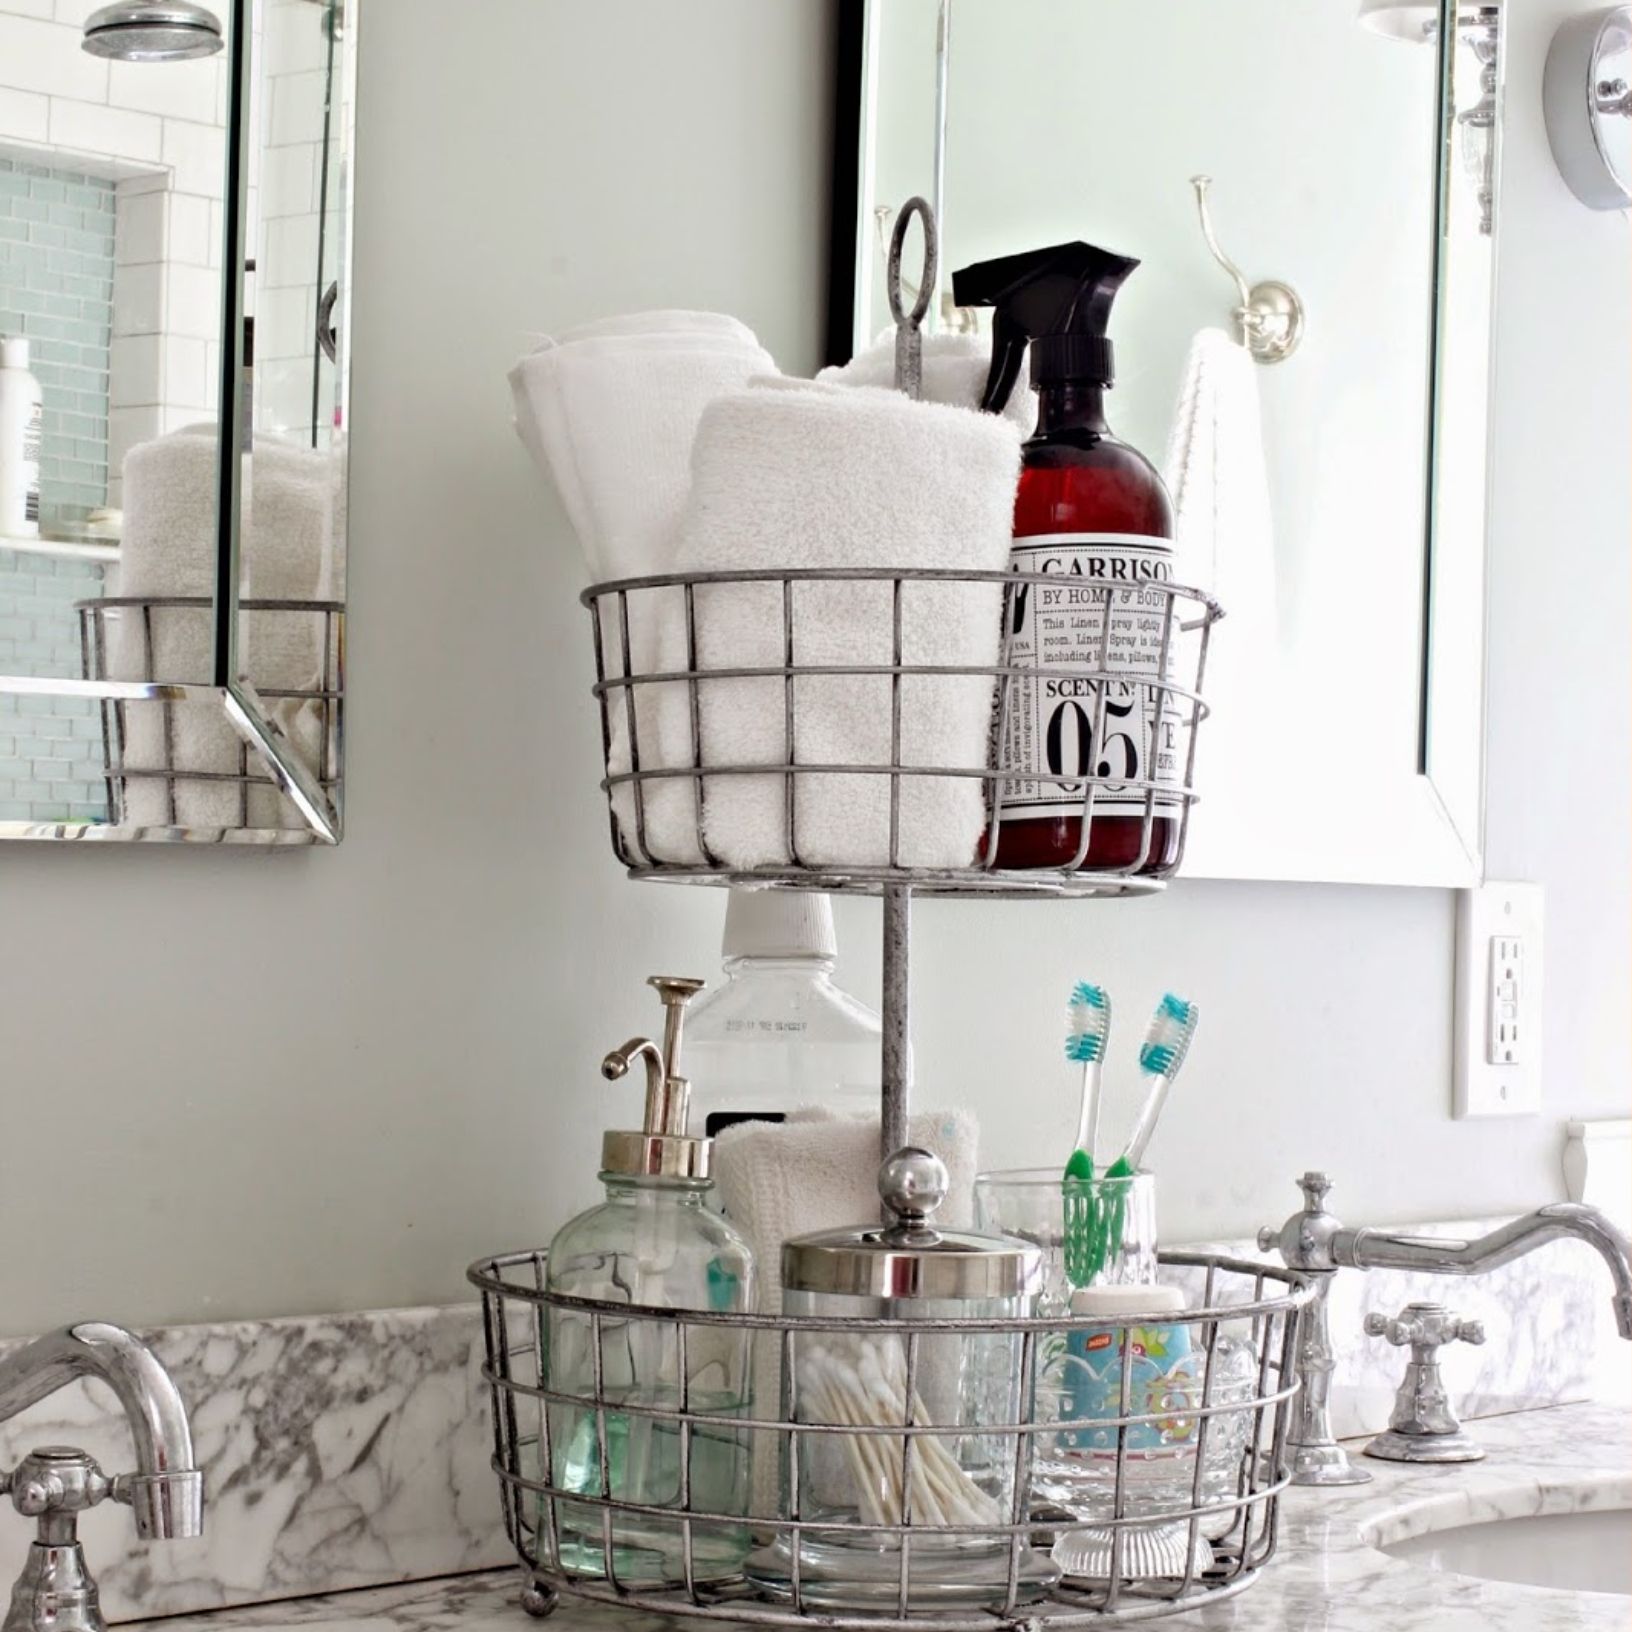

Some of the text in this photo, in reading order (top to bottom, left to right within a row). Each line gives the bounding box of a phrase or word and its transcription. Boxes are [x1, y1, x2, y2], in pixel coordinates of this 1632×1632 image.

[1043, 589, 1166, 607] BY HOM & BODY
[1043, 617, 1064, 630] This
[1071, 617, 1100, 629] Linen
[1109, 618, 1132, 631] pray
[1076, 634, 1103, 646] Linen
[1109, 634, 1136, 647] Spray
[1140, 634, 1148, 646] is
[1043, 650, 1092, 663] including
[1046, 679, 1116, 698] SCENT
[1046, 699, 1138, 792] 05
